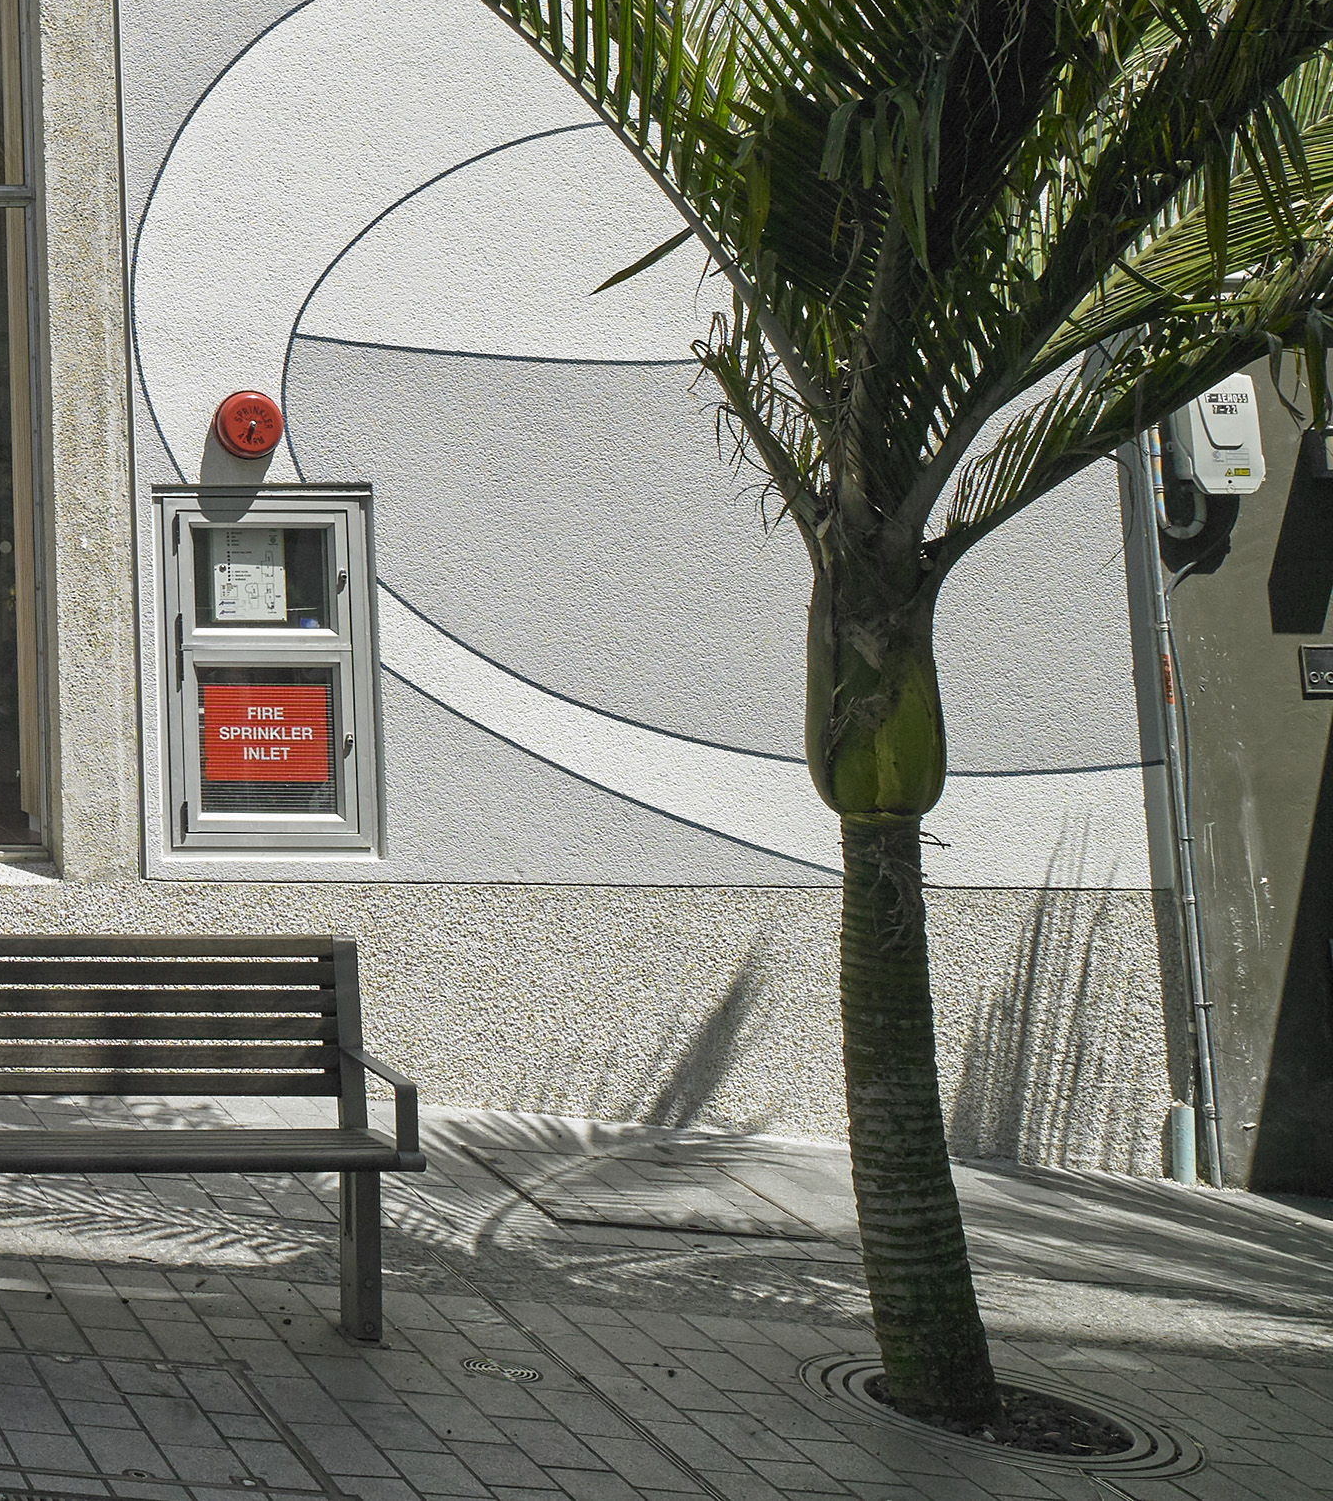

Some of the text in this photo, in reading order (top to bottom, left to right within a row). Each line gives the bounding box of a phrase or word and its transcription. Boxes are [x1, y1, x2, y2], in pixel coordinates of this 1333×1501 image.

[234, 405, 274, 429] SPRINKLER
[237, 432, 265, 445] ALARM
[247, 706, 285, 720] FIRE
[219, 726, 313, 740] SPRINKLER
[243, 747, 291, 760] INLET
